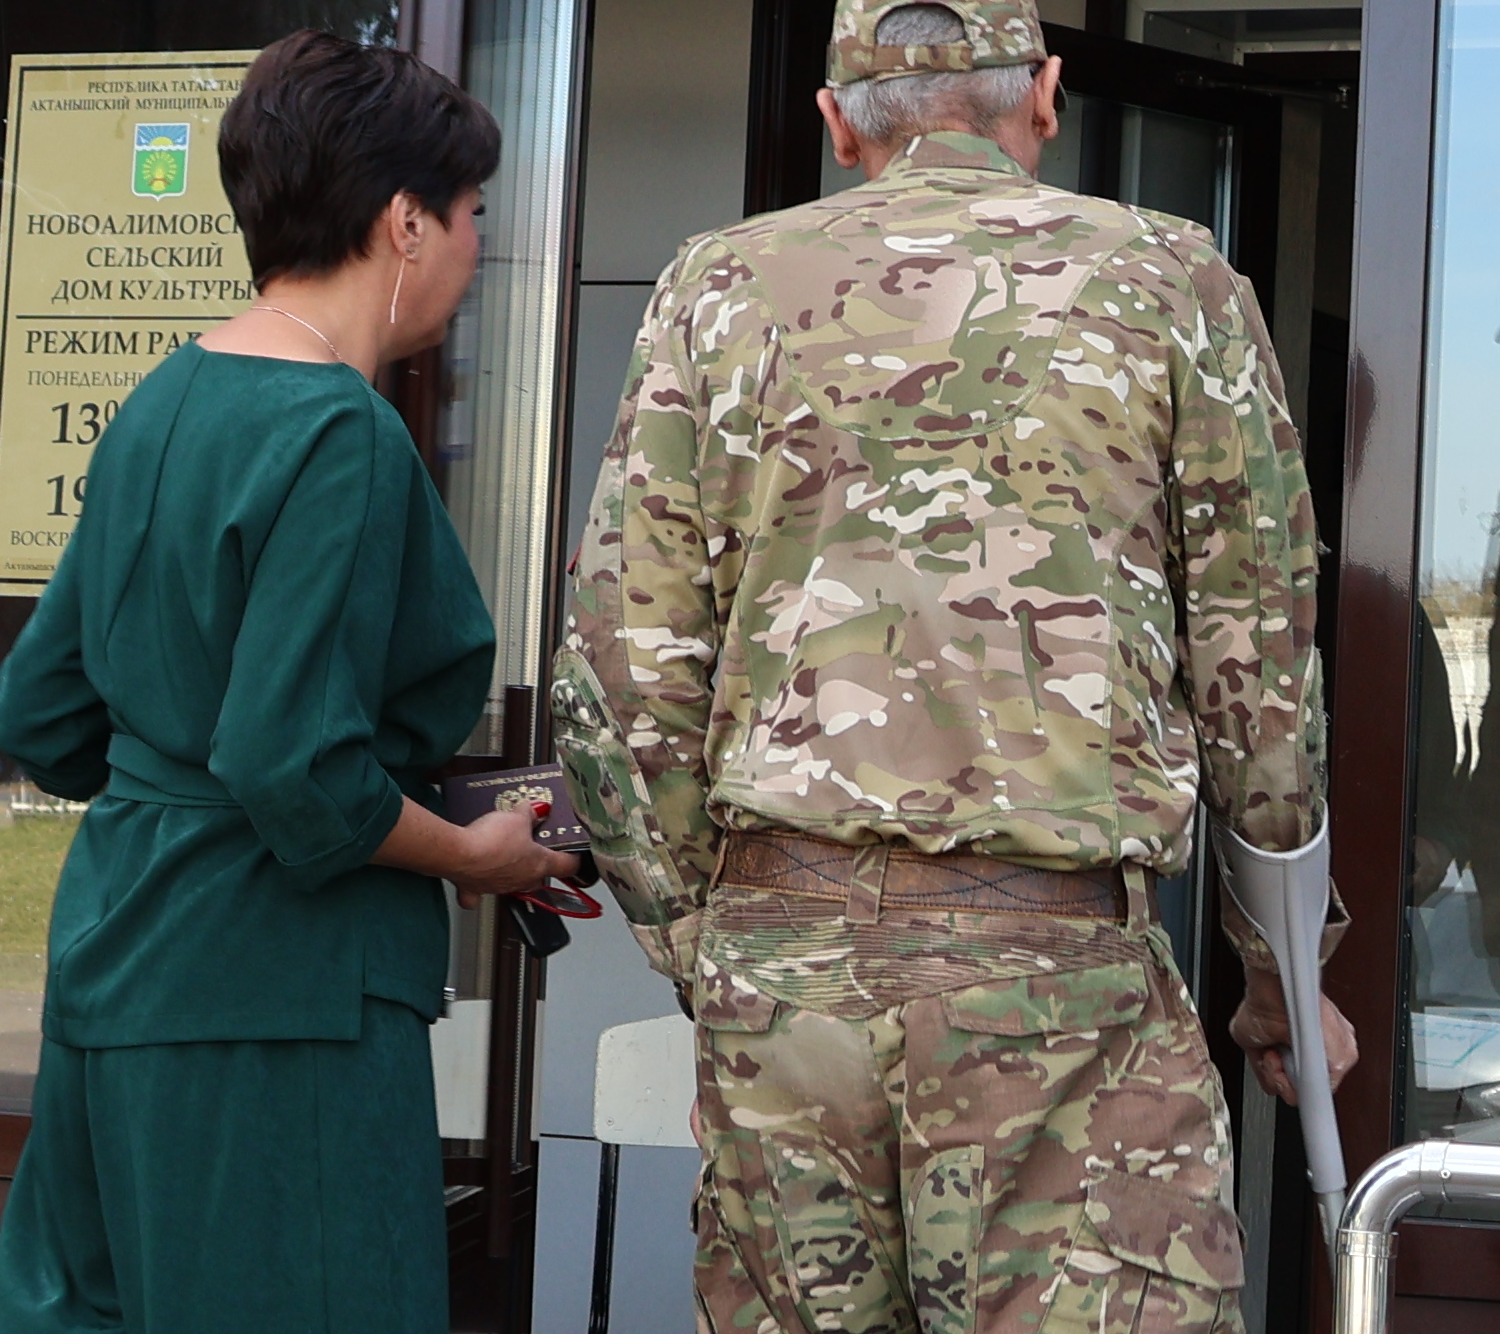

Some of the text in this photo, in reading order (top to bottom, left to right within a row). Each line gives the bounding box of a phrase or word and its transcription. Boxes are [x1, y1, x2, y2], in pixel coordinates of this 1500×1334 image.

[88, 81, 168, 93] РЕСПУБЛИКА
[30, 96, 130, 111] АКТАНЫШСКИЙ
[86, 242, 223, 268] СЕЛЬСКИЙ
[51, 280, 254, 304] ДОМ КУЛЬТУРЫ
[25, 330, 140, 355] РЕЖИМ
